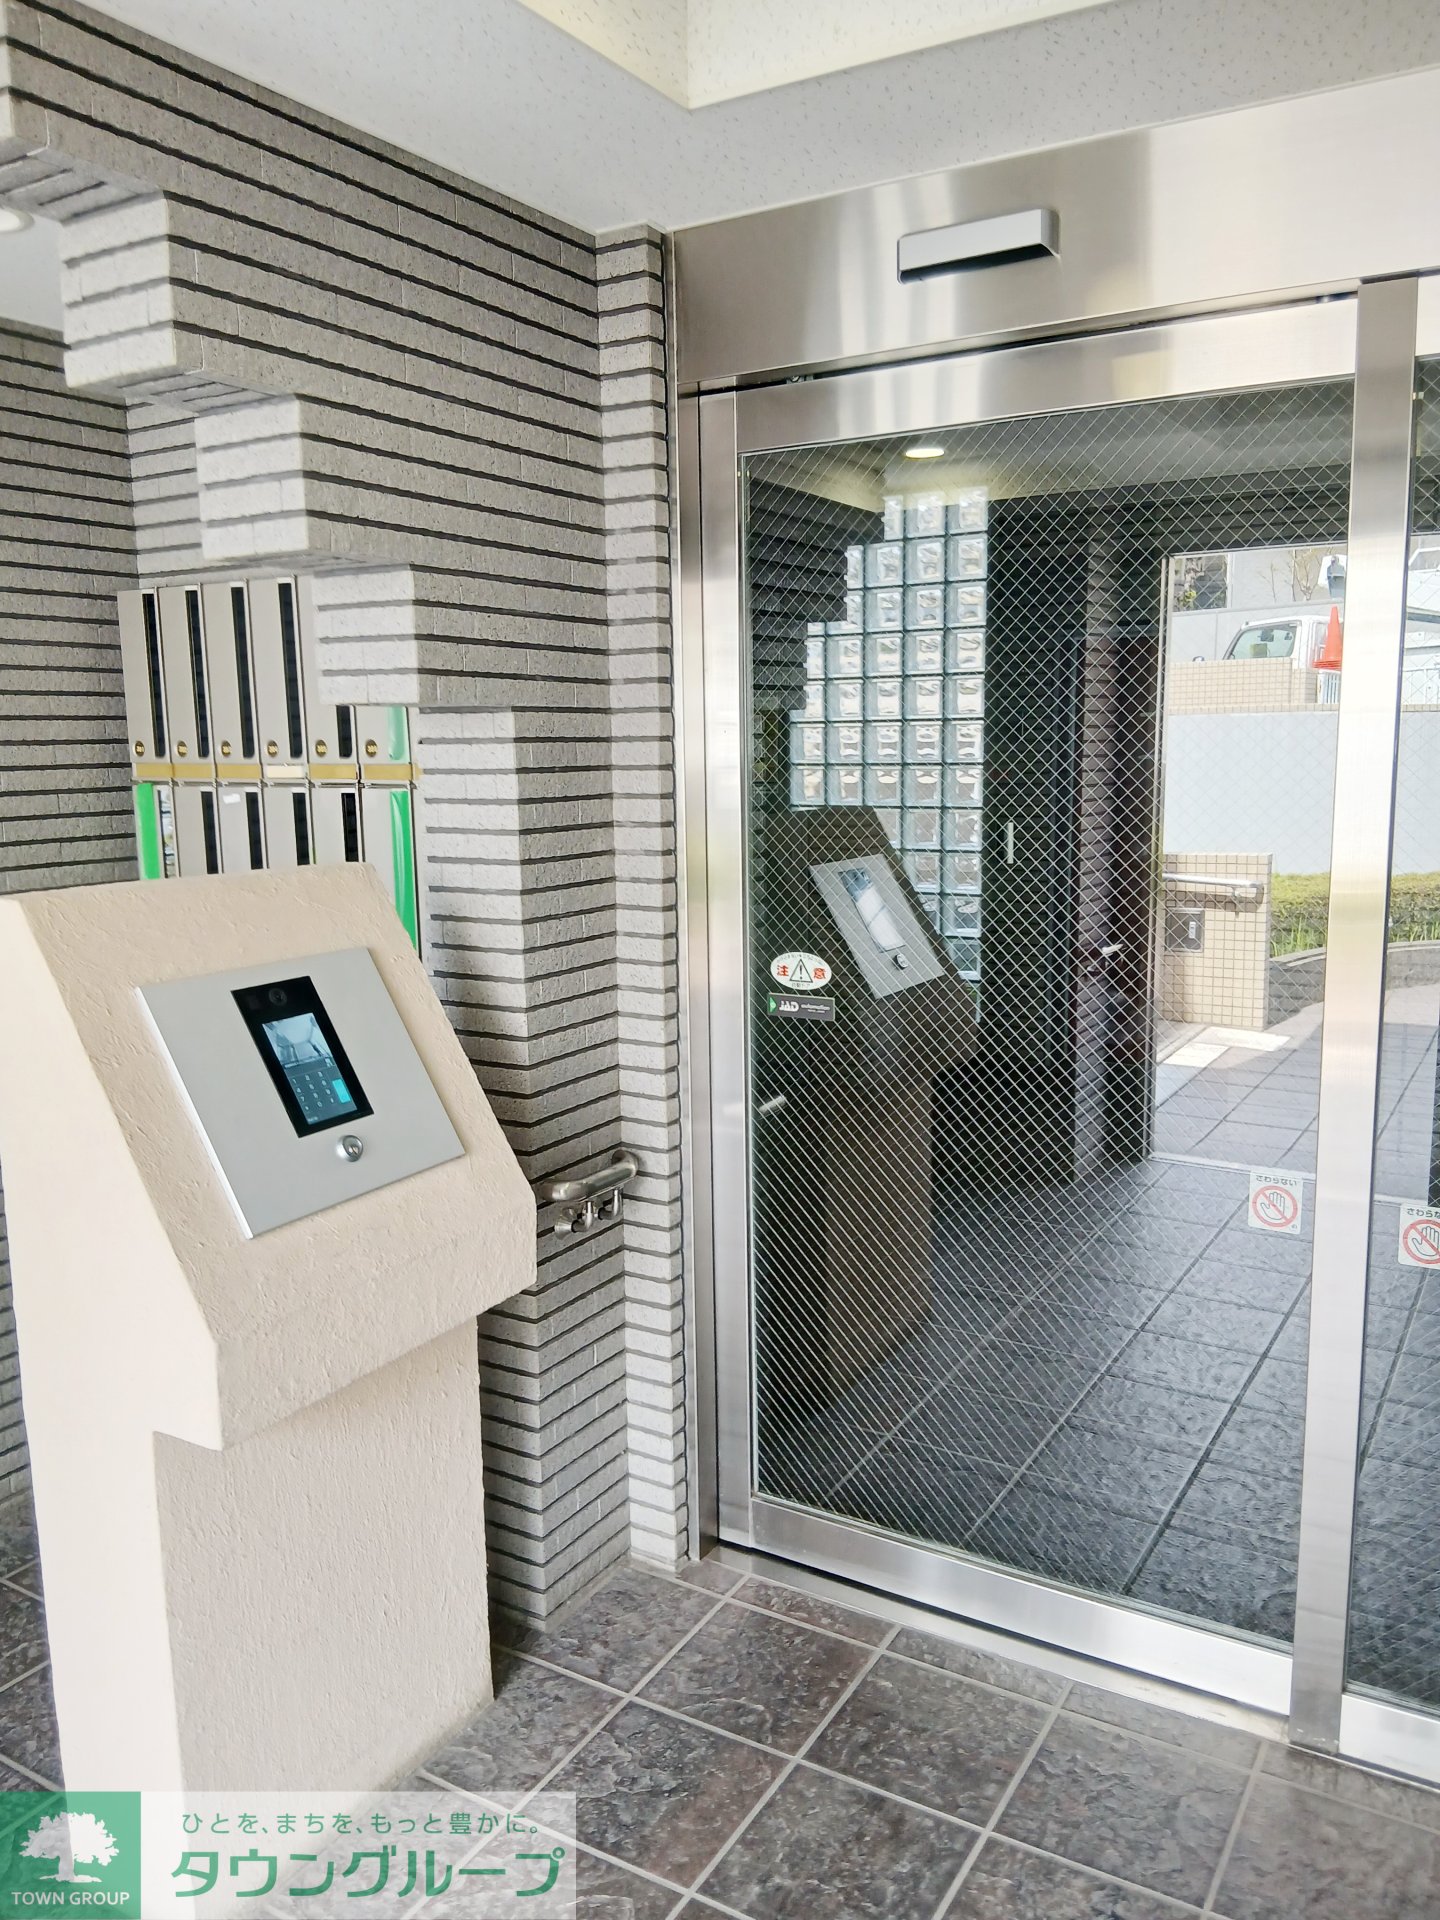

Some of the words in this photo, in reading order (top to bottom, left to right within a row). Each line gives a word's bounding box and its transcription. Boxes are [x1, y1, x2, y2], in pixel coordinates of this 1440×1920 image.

[776, 964, 789, 977] 注
[813, 967, 826, 979] 意
[1255, 1174, 1297, 1186] さわらない
